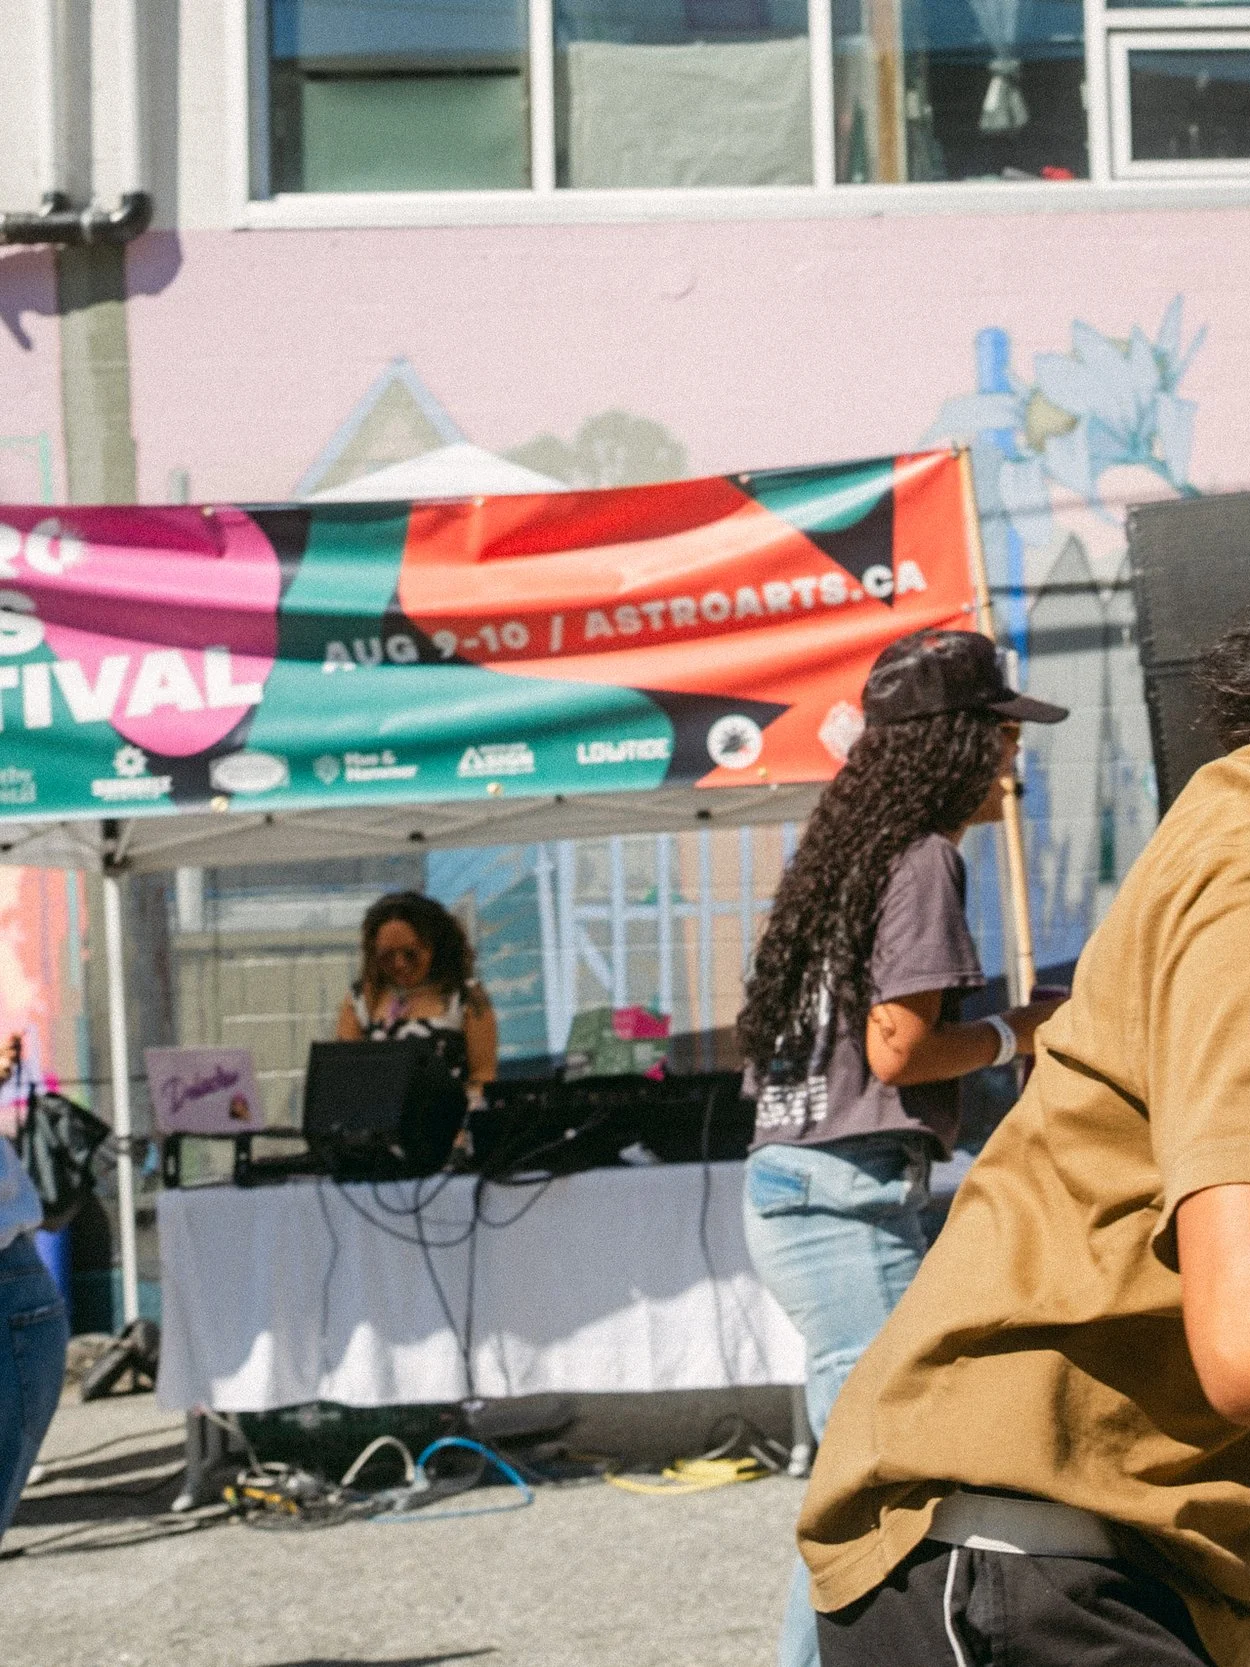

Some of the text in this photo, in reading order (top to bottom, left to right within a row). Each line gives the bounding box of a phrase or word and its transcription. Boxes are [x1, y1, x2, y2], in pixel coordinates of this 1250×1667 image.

[321, 634, 419, 676] AUG
[431, 621, 529, 660] 9-10
[584, 559, 928, 642] ASTROARTS.CA
